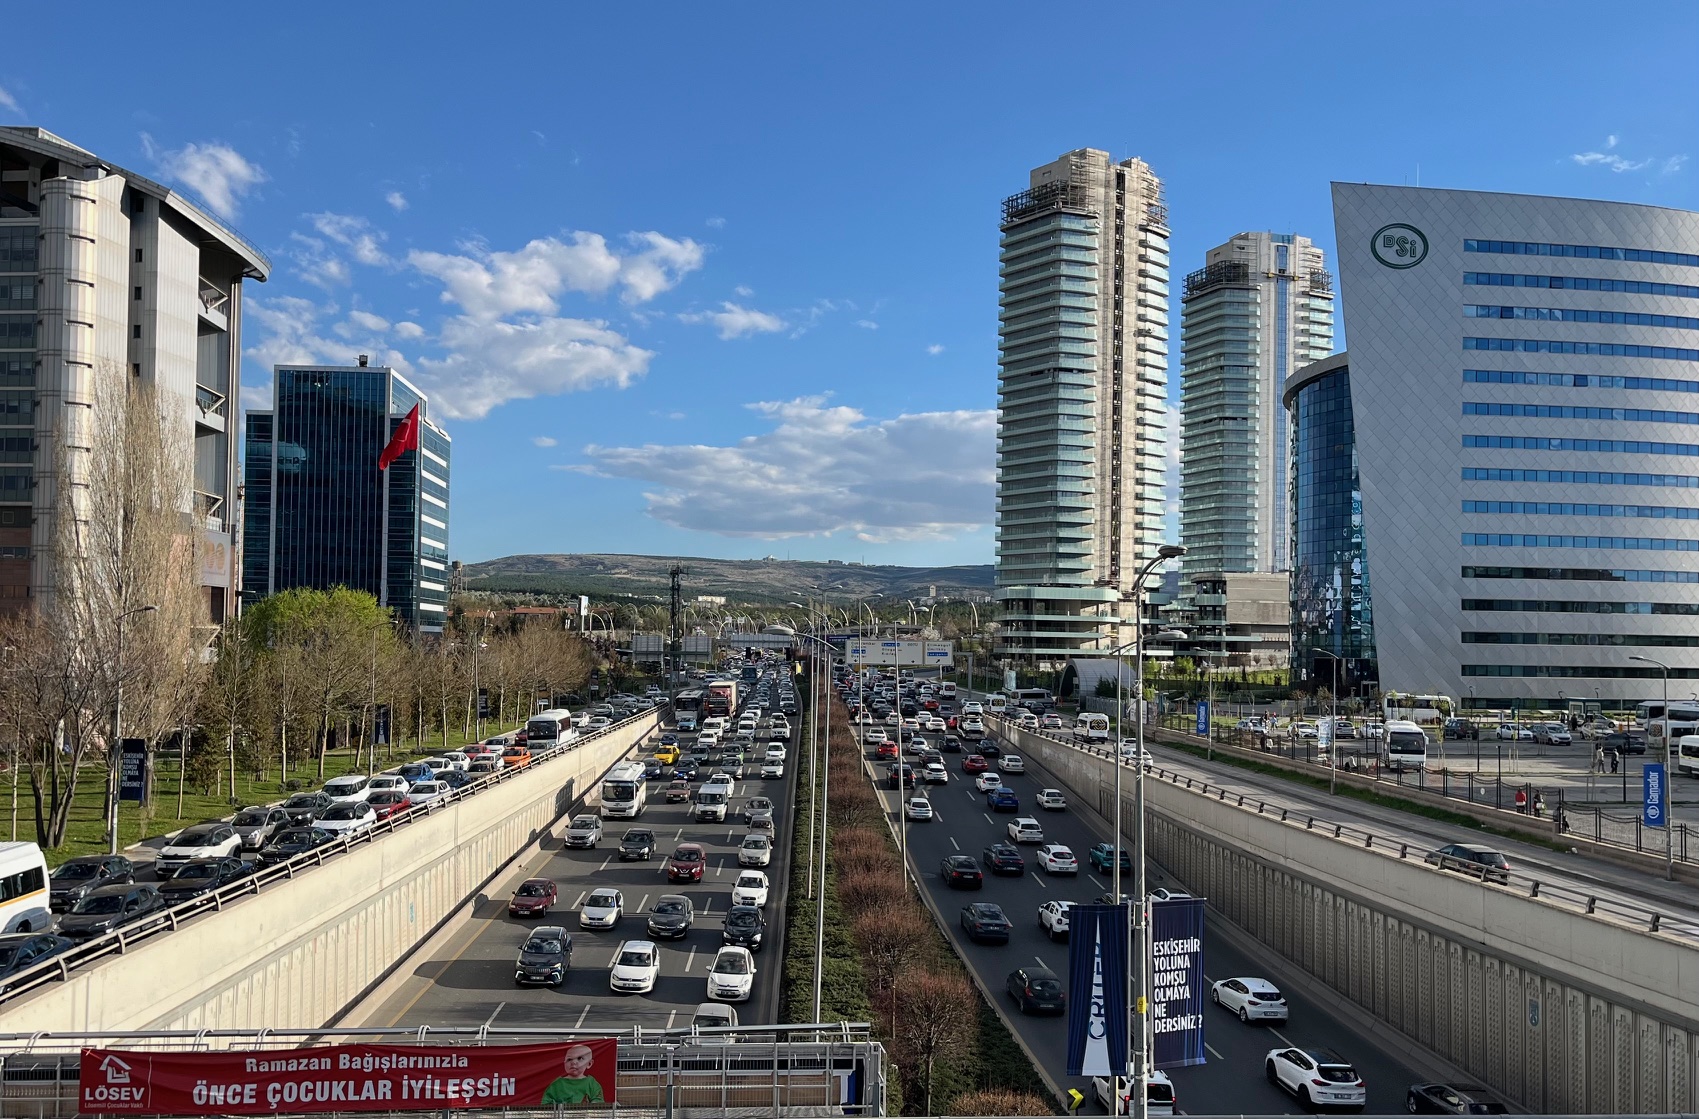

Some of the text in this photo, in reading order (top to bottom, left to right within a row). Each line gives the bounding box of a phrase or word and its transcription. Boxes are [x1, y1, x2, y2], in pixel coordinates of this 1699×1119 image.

[1153, 937, 1200, 956] ESKİŞEHİR
[1153, 955, 1191, 971] YOLUNA
[1154, 970, 1186, 987] KOMŞU
[1154, 985, 1191, 1002] OLMAYA
[1154, 1003, 1167, 1018] NE
[1154, 1013, 1196, 1034] DERSİNİZ
[246, 1053, 468, 1073] Ramazan Bağışlarınızla
[85, 1085, 145, 1101] LÖSEV
[192, 1073, 516, 1109] ÖNCE ÇOCUKLAR İYİLEŞSİN
